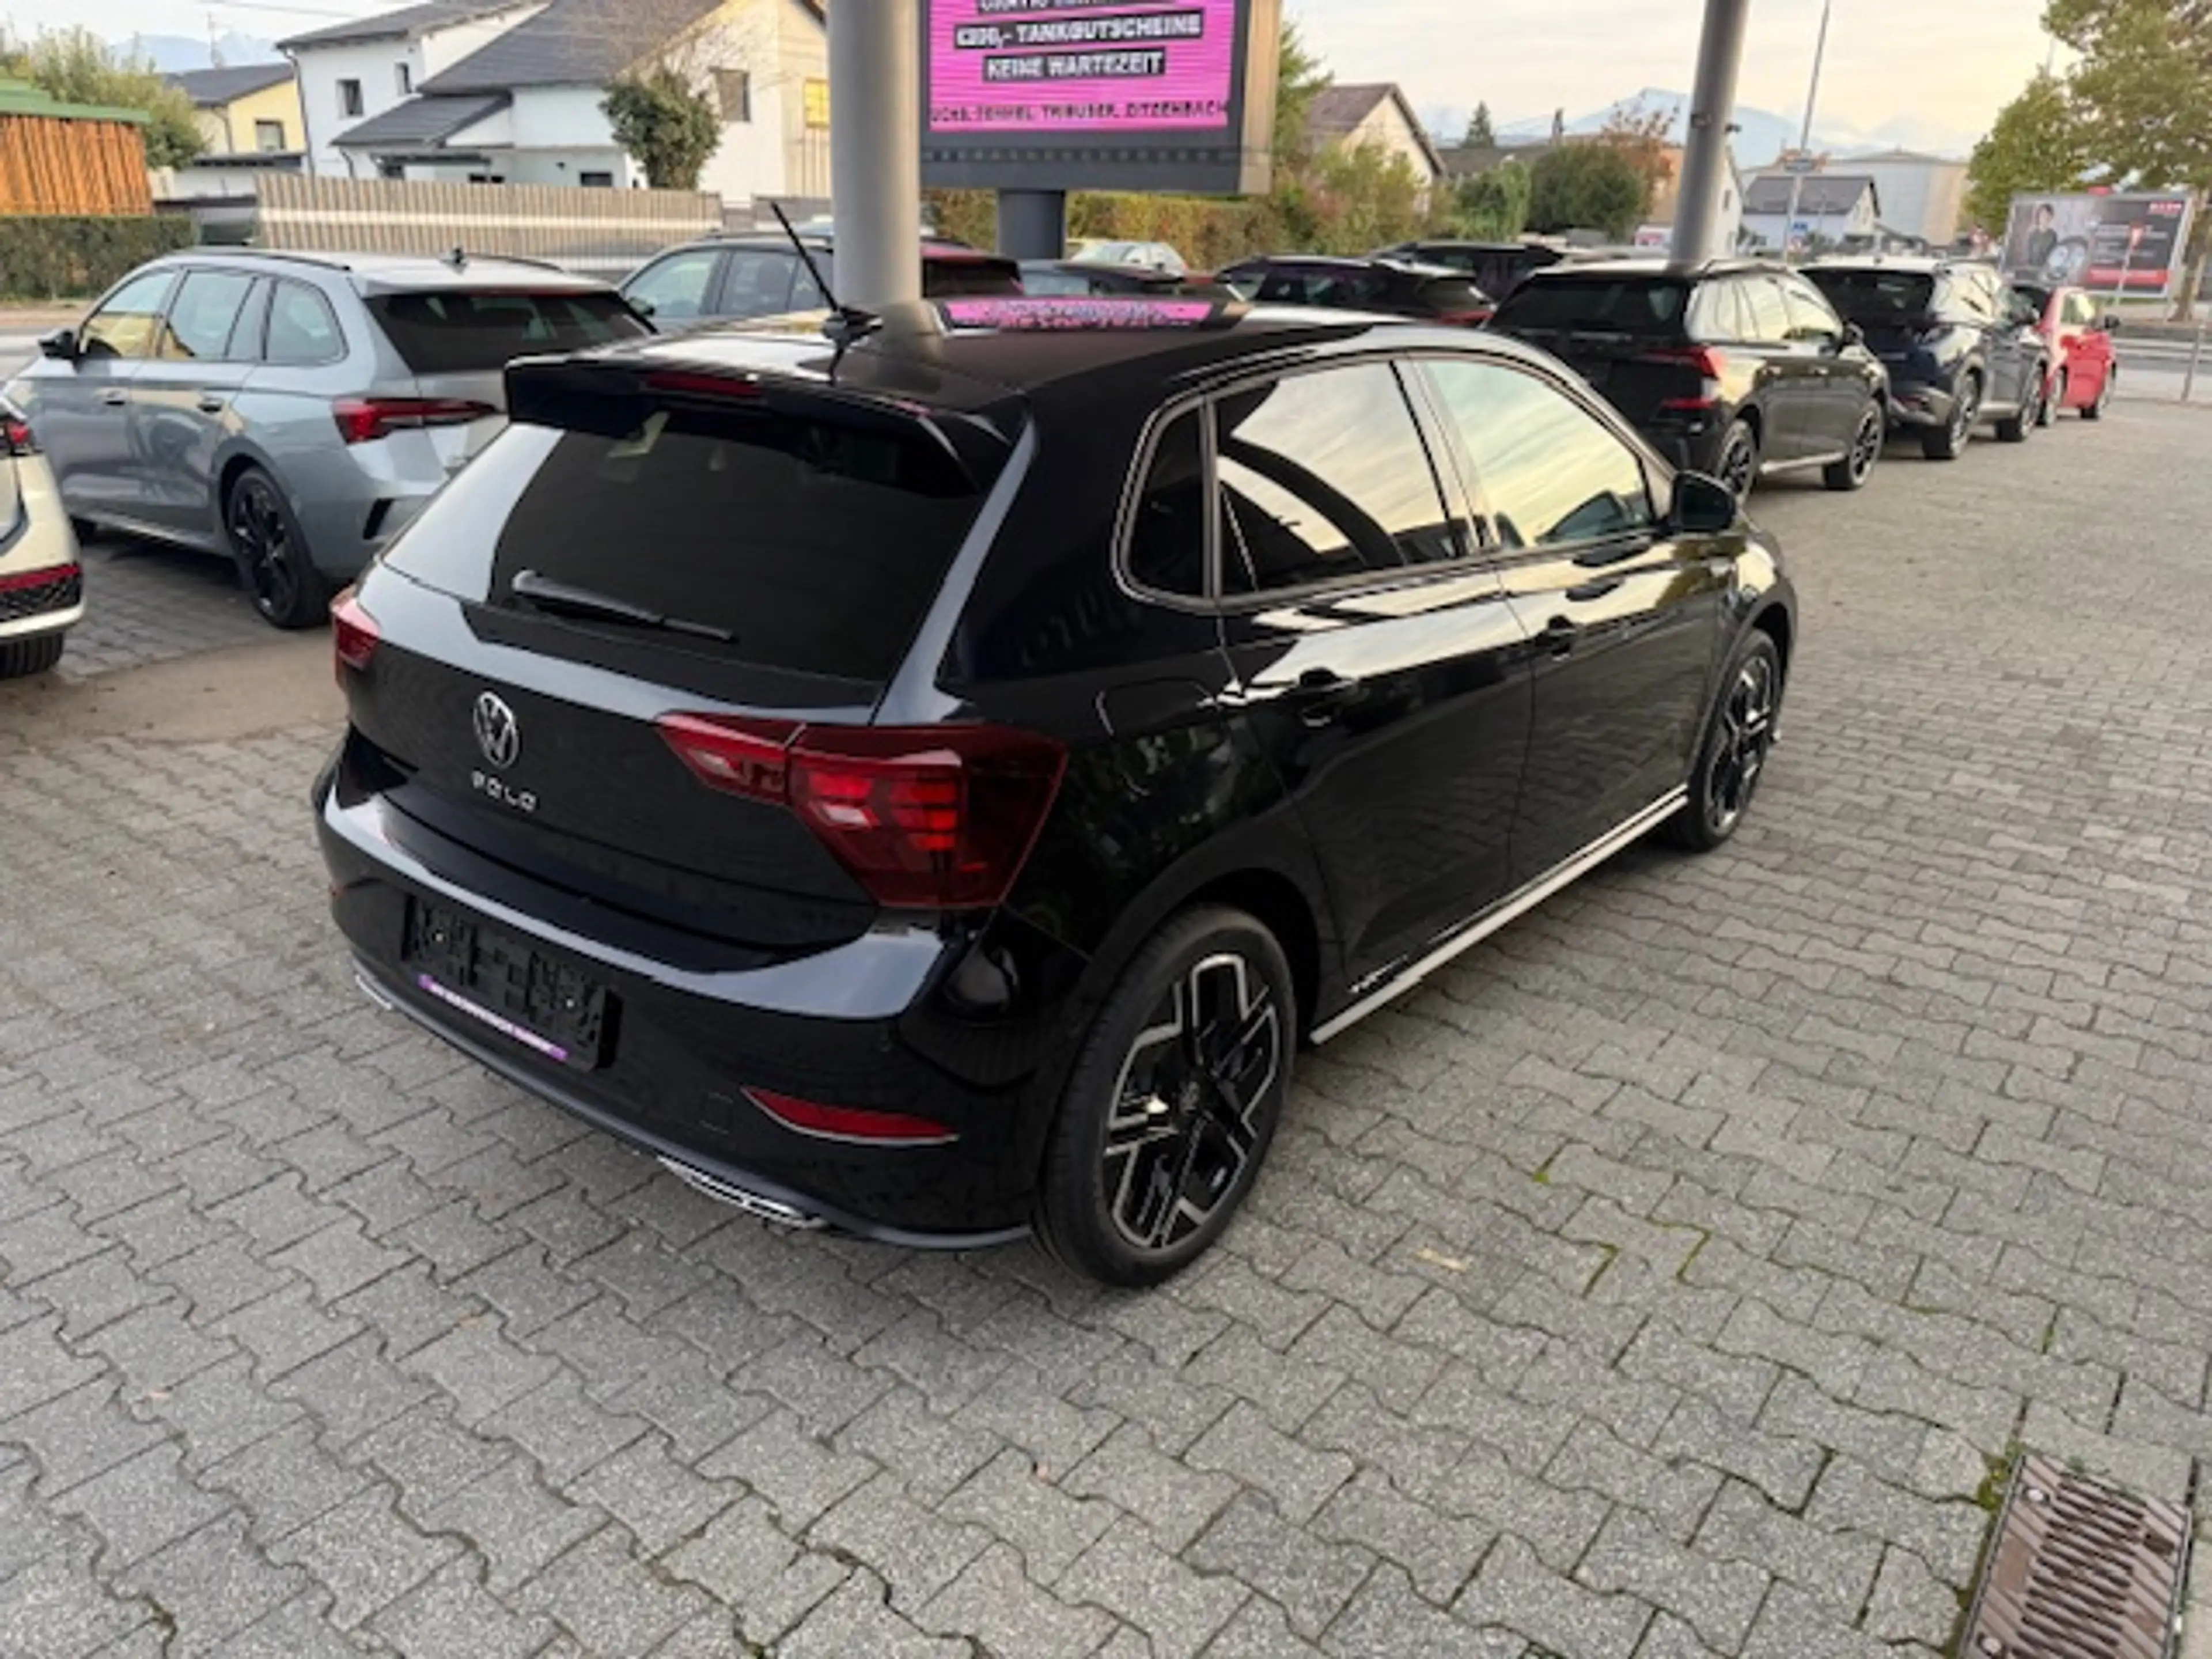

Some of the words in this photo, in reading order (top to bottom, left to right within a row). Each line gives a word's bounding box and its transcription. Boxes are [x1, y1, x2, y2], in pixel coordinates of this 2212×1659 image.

[1016, 13, 1201, 43] TANKGUTSCHEINE
[987, 56, 1044, 79] KEINE
[1047, 51, 1163, 77] WARTEZEIT
[471, 770, 537, 812] POLO
